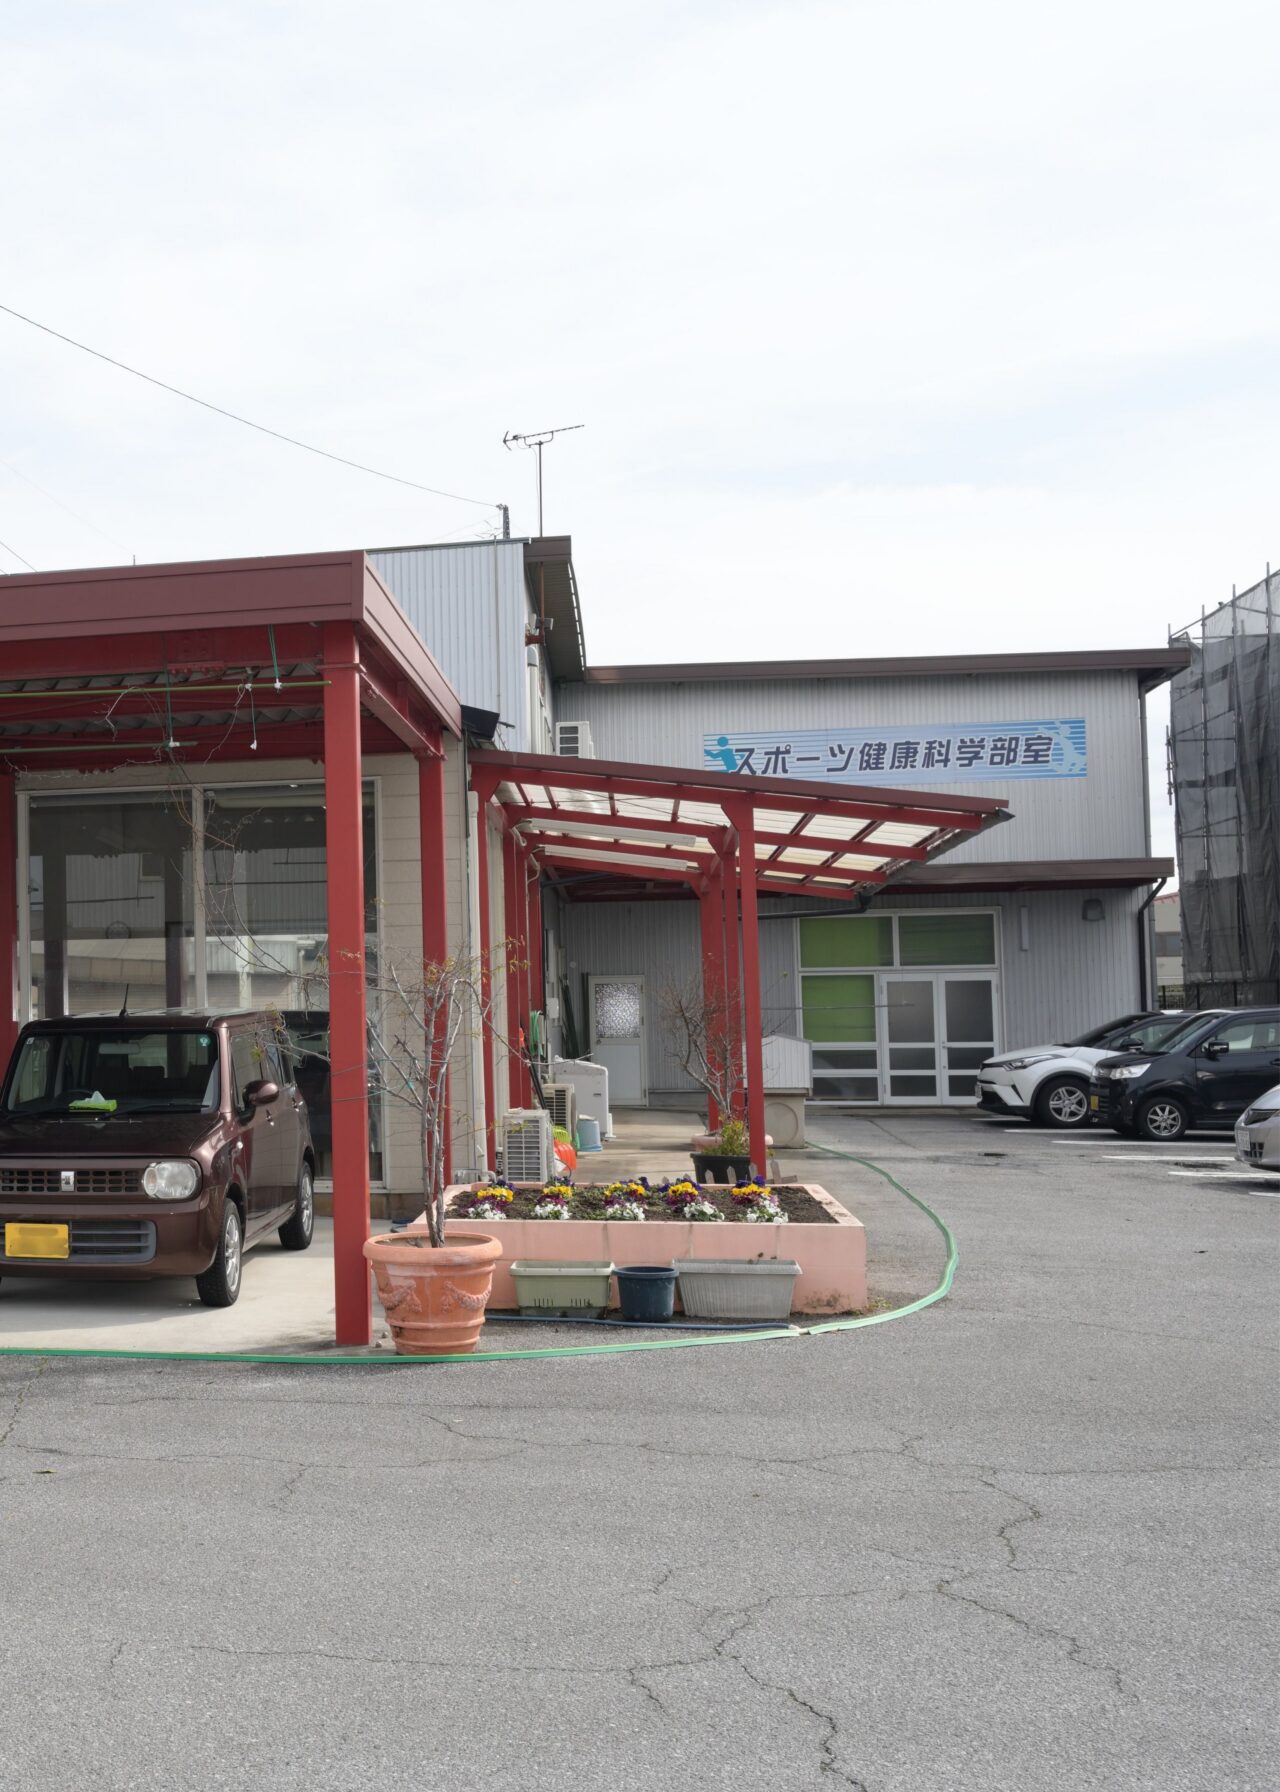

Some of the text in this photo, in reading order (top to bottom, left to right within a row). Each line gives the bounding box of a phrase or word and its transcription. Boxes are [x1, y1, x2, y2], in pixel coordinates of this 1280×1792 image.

[730, 734, 1053, 775] スポーツ健康科学部室
